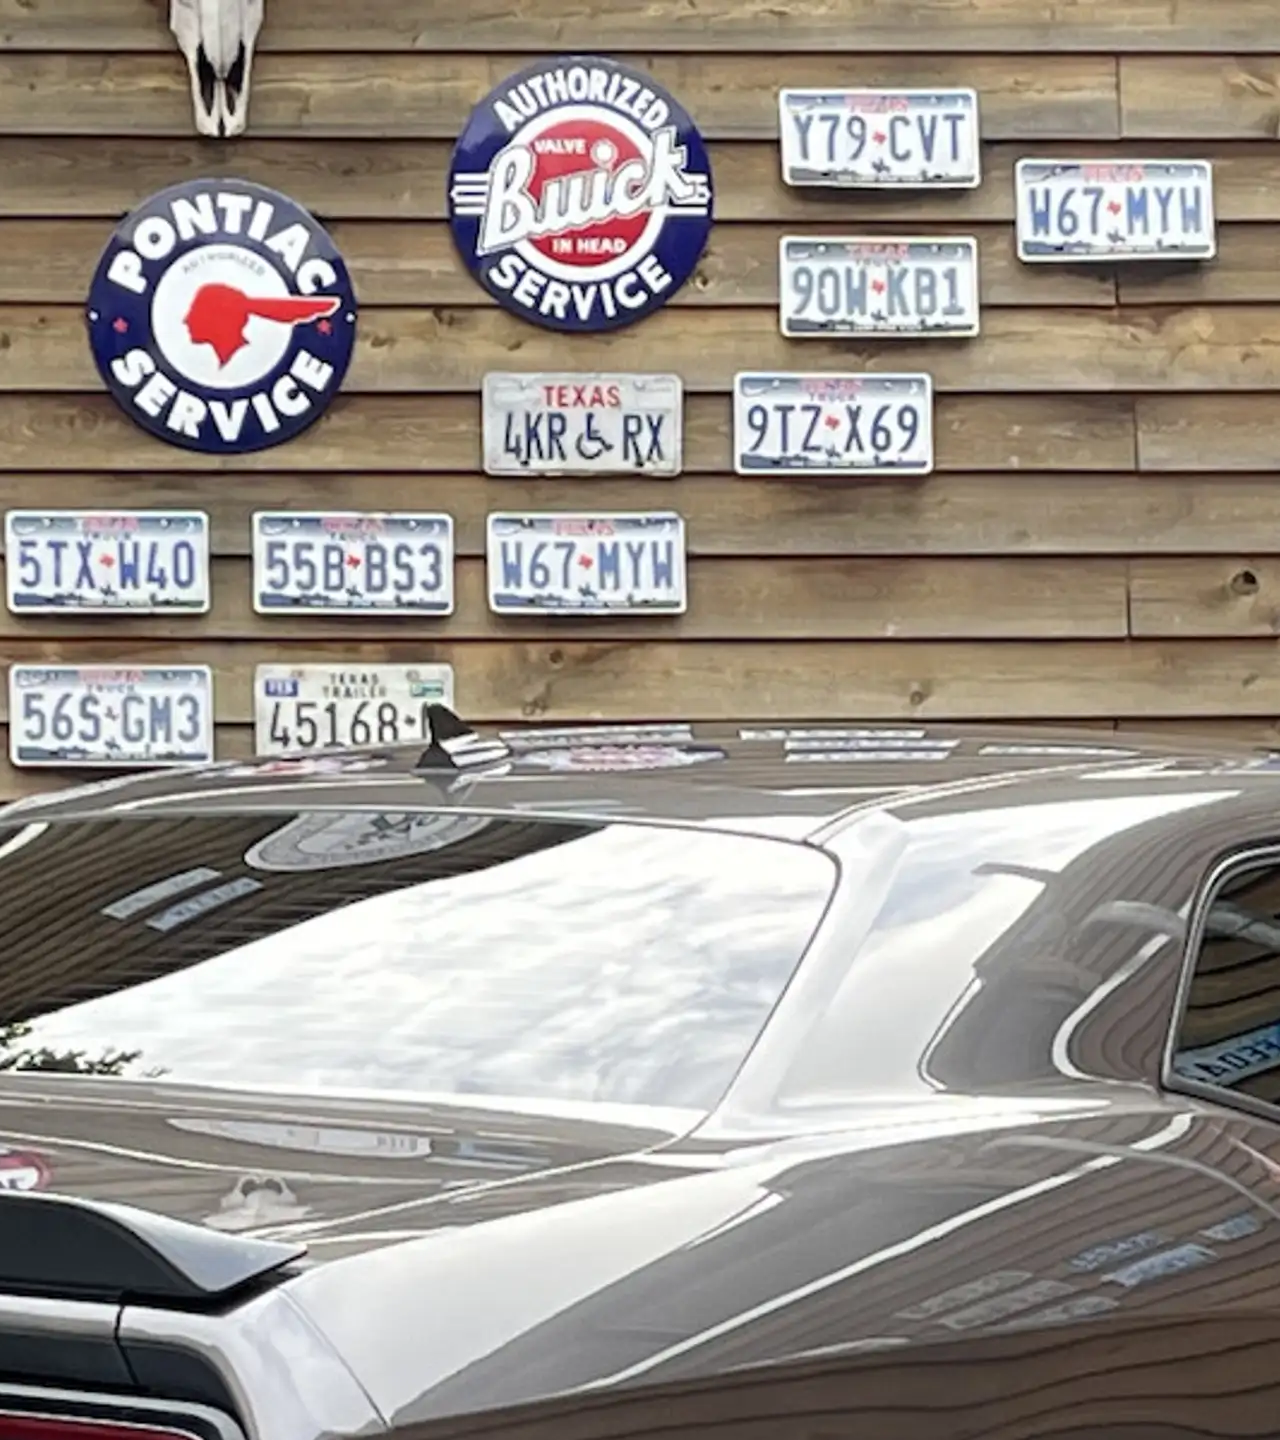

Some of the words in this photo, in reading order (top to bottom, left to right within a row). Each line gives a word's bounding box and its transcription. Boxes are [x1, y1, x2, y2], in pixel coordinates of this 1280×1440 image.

[493, 67, 669, 131] AUTHORIZED
[534, 138, 587, 154] VALVE
[793, 114, 867, 162] Y79
[889, 114, 965, 162] CVT
[476, 126, 697, 257] Buick
[1029, 187, 1104, 236] W67
[1126, 186, 1201, 235] MYW
[107, 192, 337, 294] PONTIAC
[552, 238, 571, 253] IN
[577, 238, 626, 254] HEAD
[489, 255, 672, 320] SERVICE
[887, 267, 965, 315] KB1
[111, 349, 333, 442] SERVICE
[544, 385, 621, 407] TEXAS
[504, 411, 568, 462] 4KR
[623, 414, 665, 462] RX
[747, 405, 822, 452] 9TZ
[844, 405, 919, 452] X69
[19, 540, 96, 589] 5TX
[119, 541, 194, 589] W40
[267, 541, 344, 592] 55B
[365, 543, 442, 593] BS3
[501, 541, 577, 589] W67
[597, 540, 674, 591] MYW
[24, 693, 101, 742] 56S
[122, 693, 200, 743] GM3
[270, 700, 399, 748] 45168
